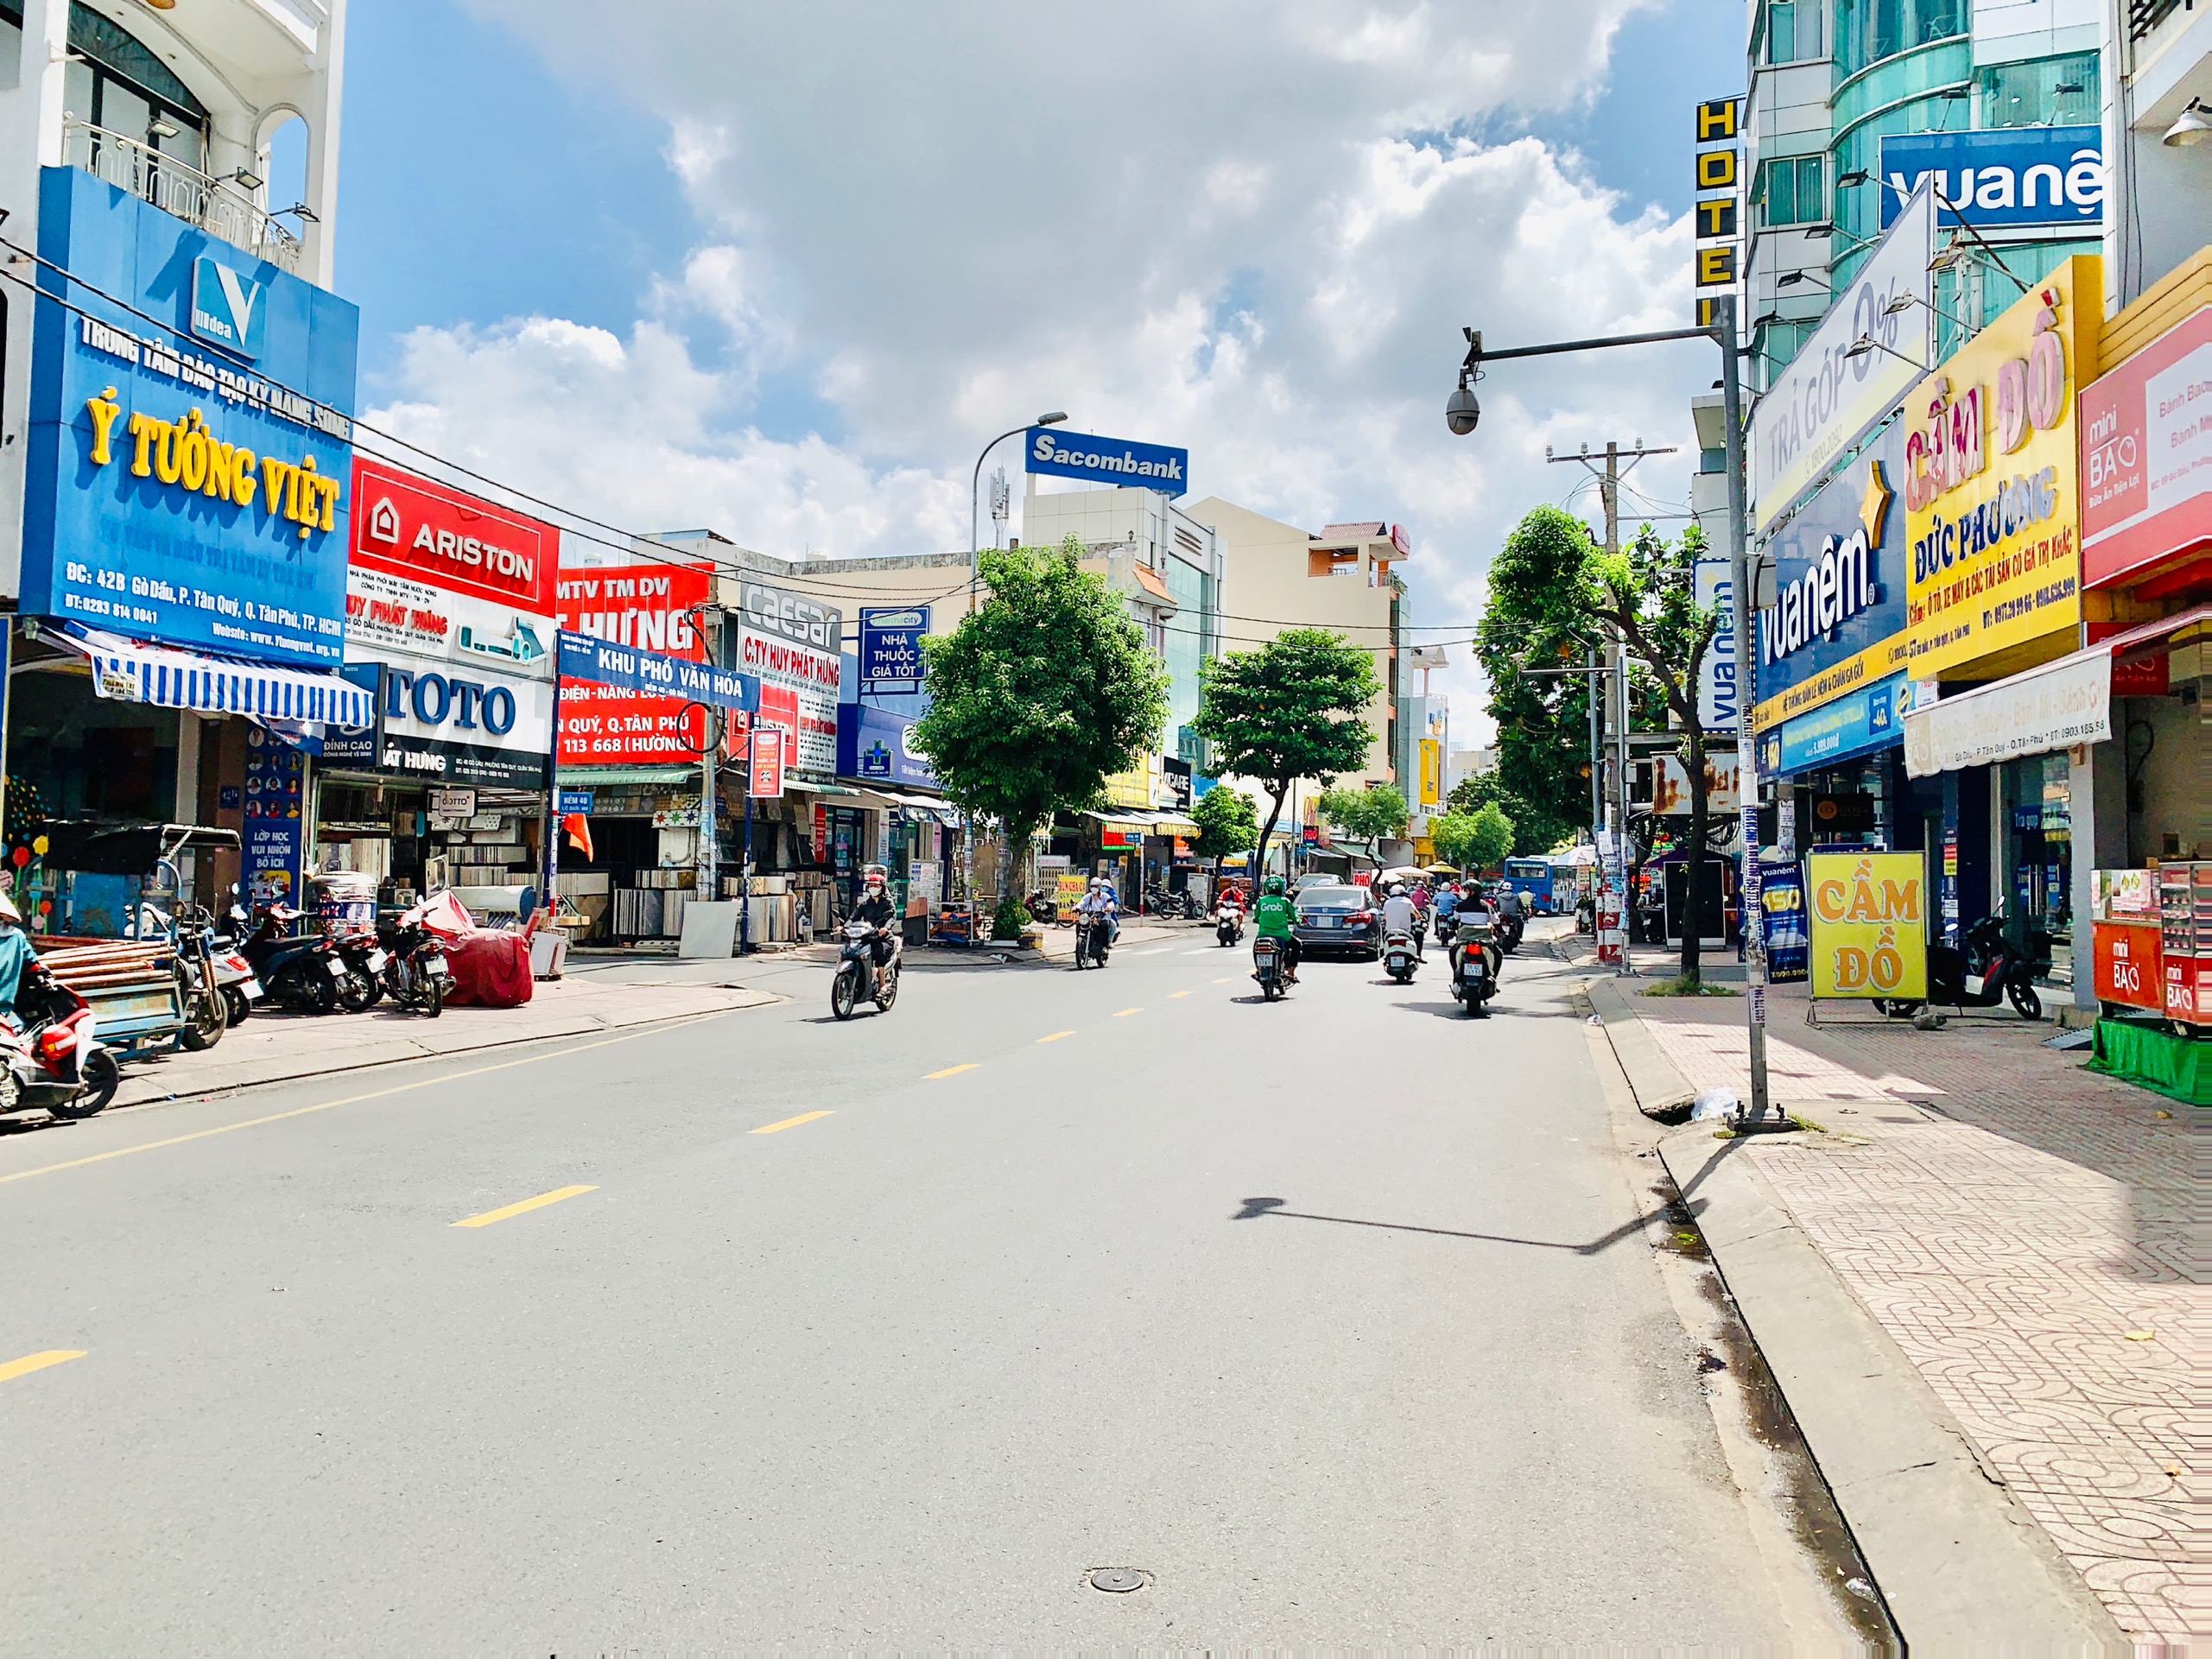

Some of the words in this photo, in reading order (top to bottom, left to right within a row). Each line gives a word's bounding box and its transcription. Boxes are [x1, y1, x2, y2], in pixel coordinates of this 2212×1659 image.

[1890, 149, 2103, 215] vuanệ
[80, 316, 139, 364] TRUNG
[143, 337, 180, 379] TÂM
[1769, 378, 1801, 480] TRẢ
[1804, 343, 1846, 440] GÓP
[1906, 377, 1985, 513] CẦM
[1998, 288, 2066, 455] ĐỒ
[2088, 403, 2117, 444] mini
[87, 385, 120, 465] Ý
[130, 406, 257, 508] TƯỞNG
[262, 454, 340, 539] VIỆT
[1033, 434, 1183, 480] Sacombank
[1914, 515, 1954, 586] ĐỨC
[1959, 465, 2059, 561] PHƯƠNG
[413, 522, 534, 582] ARISTON
[67, 561, 92, 585] ĐC:
[97, 568, 125, 592] 42B
[132, 575, 149, 598] Gò
[179, 589, 191, 606] P.
[193, 590, 215, 611] Tân
[244, 604, 256, 620] Q.
[258, 604, 277, 623] Tân
[302, 616, 317, 633] TP.
[318, 617, 341, 637] HCM
[605, 579, 636, 598] TM
[639, 577, 669, 597] DV
[1760, 529, 1870, 667] vuanệm
[346, 593, 367, 617] UY
[371, 599, 408, 627] PHÁT
[212, 622, 249, 642] Website:
[250, 630, 274, 646] www.
[874, 648, 915, 662] THUỐC
[881, 632, 908, 645] NHÀ
[599, 648, 635, 674] KHU
[640, 656, 674, 683] PHỐ
[679, 665, 710, 691] VĂN
[714, 672, 743, 698] HÓA
[770, 643, 789, 672] HUY
[791, 648, 814, 679] PHÁT
[871, 666, 891, 677] GIÁ
[894, 663, 916, 677] TỐT
[385, 667, 517, 735] TOTO
[569, 715, 603, 732] QUÝ,
[607, 713, 656, 732] Q.TÂN
[659, 712, 689, 731] PHÚ
[324, 738, 347, 750] ĐỈNH
[350, 741, 373, 750] CAO
[383, 742, 402, 768] ÁT
[404, 750, 447, 771] HƯNG
[564, 739, 587, 753] 113
[593, 738, 621, 752] 668
[1260, 902, 1283, 912] Grab
[1816, 858, 1921, 924] CẦM
[1834, 926, 1904, 992] ĐỒ
[2113, 939, 2128, 958] mini
